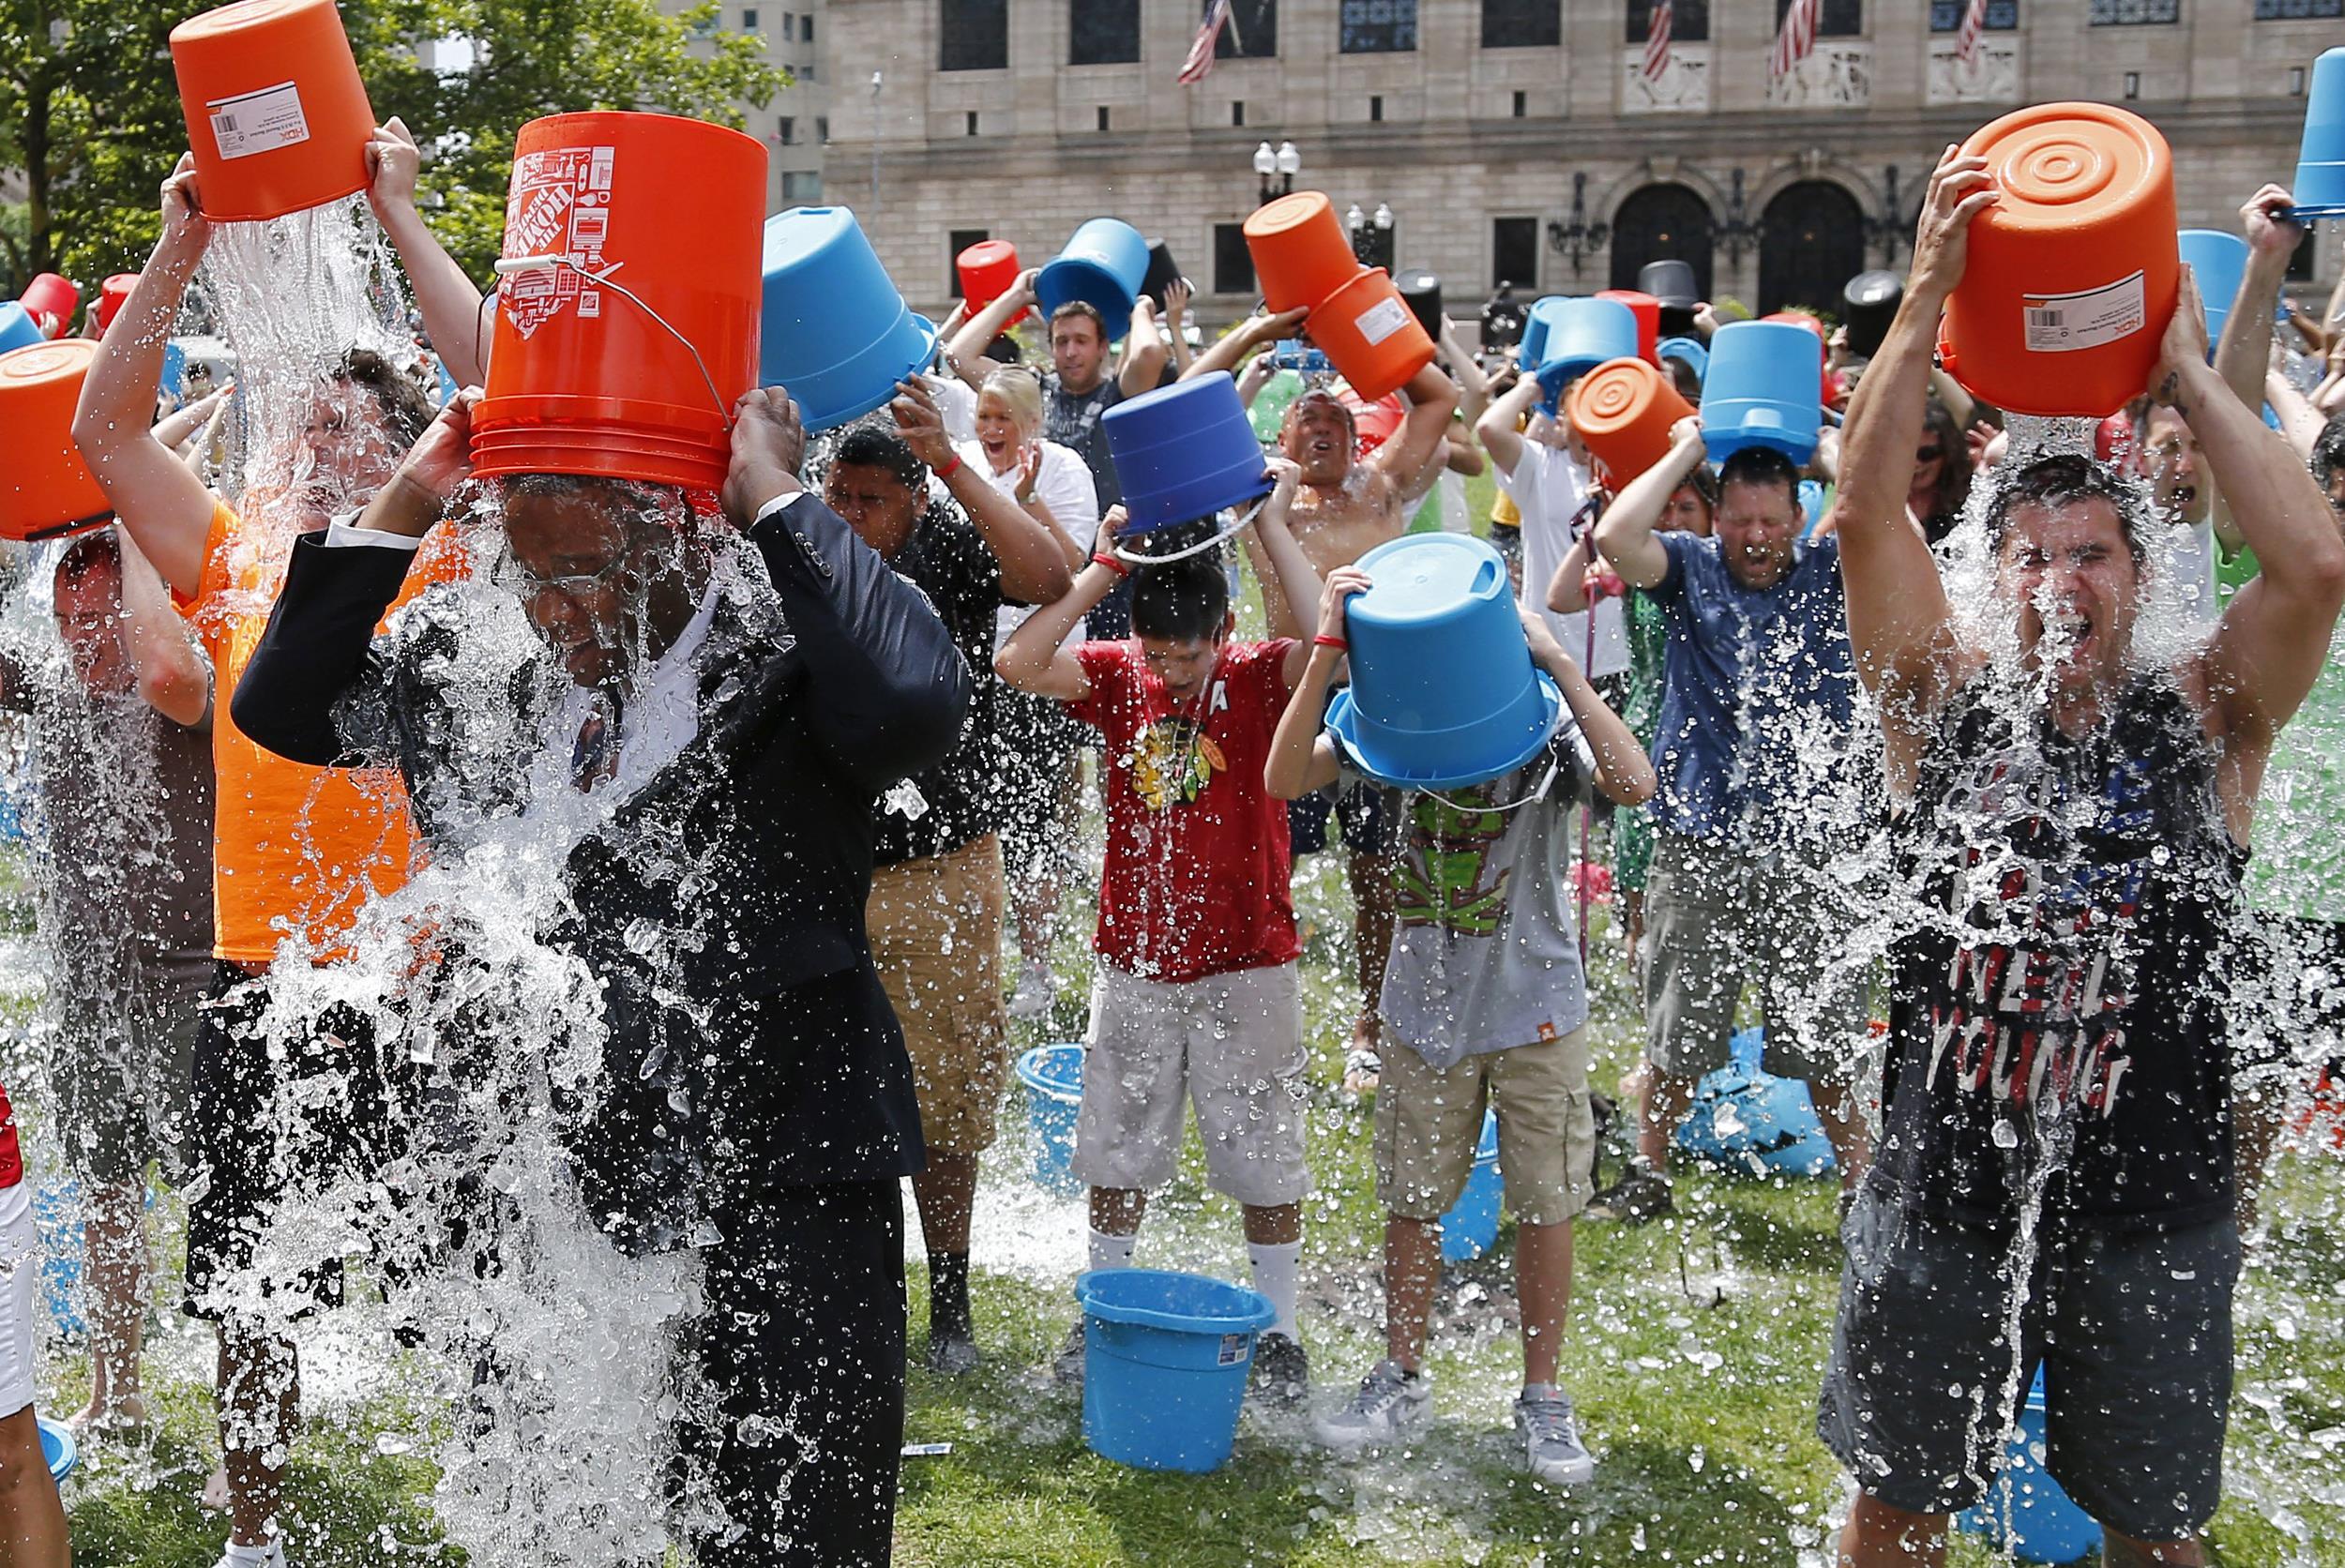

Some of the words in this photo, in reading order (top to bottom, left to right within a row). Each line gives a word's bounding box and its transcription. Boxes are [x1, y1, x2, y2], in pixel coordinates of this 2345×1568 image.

[280, 128, 305, 141] HDX
[538, 220, 564, 252] THE
[1209, 680, 1228, 716] A
[1948, 942, 2135, 1020] NEIL
[1926, 1005, 2132, 1120] YOUNG
